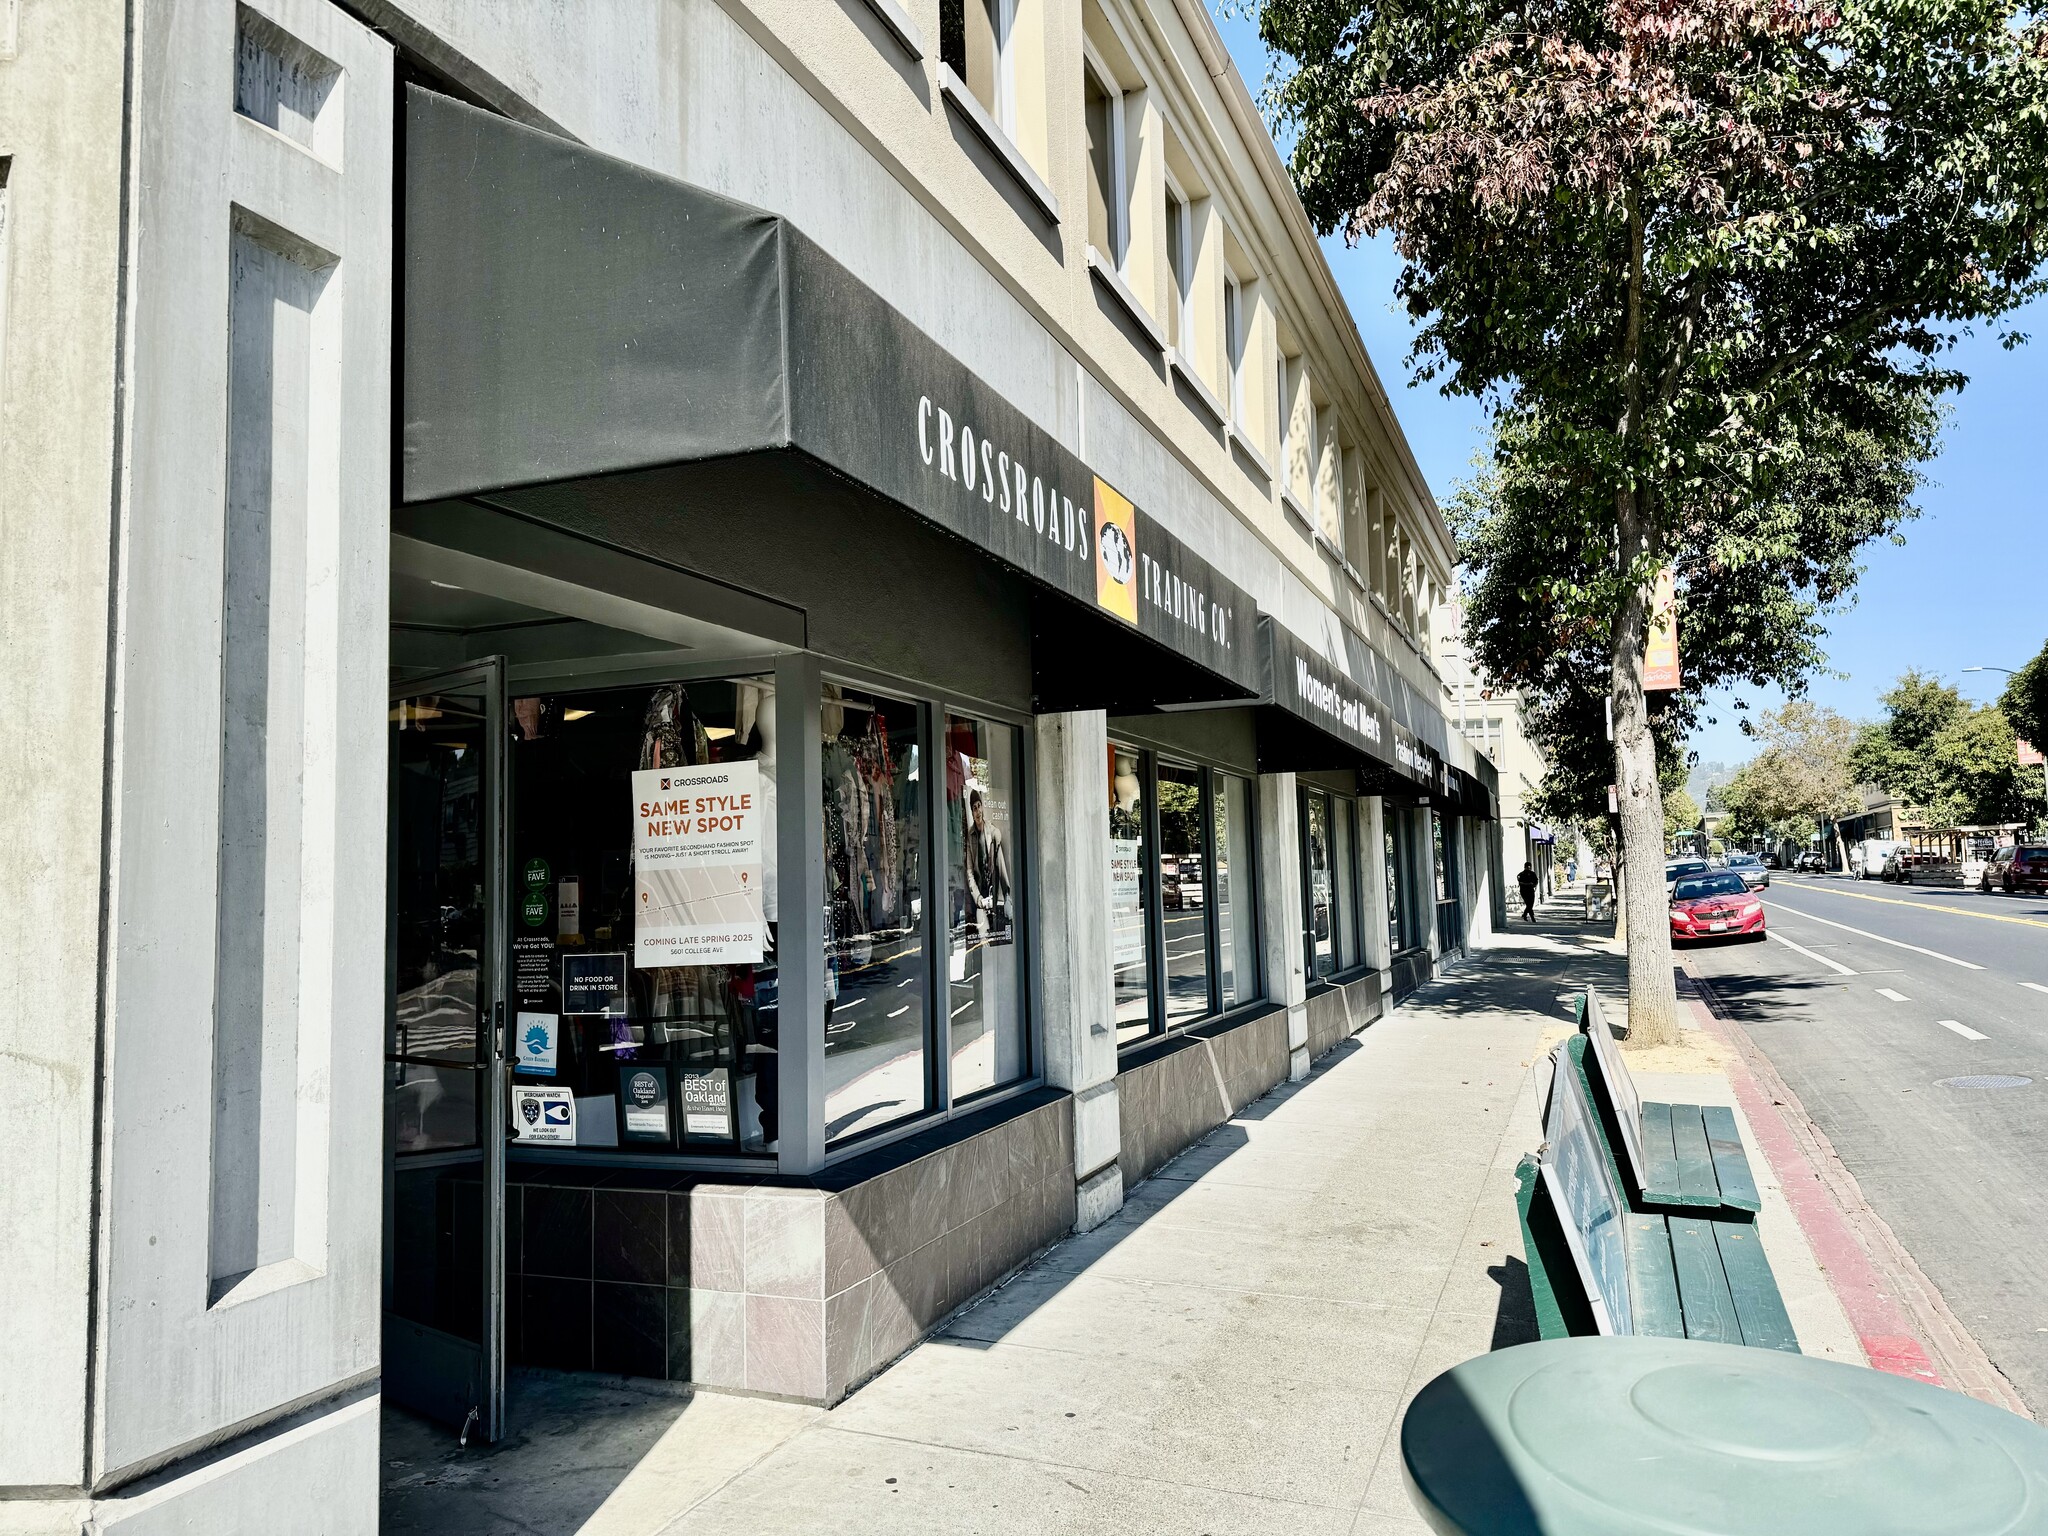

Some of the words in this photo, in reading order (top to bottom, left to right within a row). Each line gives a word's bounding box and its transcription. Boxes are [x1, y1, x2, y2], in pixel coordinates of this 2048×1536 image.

[918, 395, 1088, 561] CROSSROADS
[1142, 552, 1205, 635] TRADING
[1295, 655, 1341, 721] Women's
[1342, 698, 1358, 731] and
[1359, 702, 1381, 744] Men's
[673, 774, 729, 788] CROSSROADS
[640, 799, 690, 818] SAME
[695, 794, 752, 814] STYLE
[648, 819, 691, 837] NEW
[697, 815, 744, 834] SPOT
[654, 845, 679, 853] FAVORITE
[679, 843, 716, 851] SECONDHAND
[1123, 859, 1137, 869] STYLE
[527, 871, 546, 882] FAVE
[525, 906, 544, 916] FAVE
[643, 937, 677, 946] COMING
[679, 936, 699, 945] LATE
[701, 934, 730, 944] SPRING
[732, 933, 753, 942] 2025
[684, 947, 711, 955] COLLEGE
[569, 984, 589, 992] DRINK
[634, 1080, 648, 1088] BEST
[647, 1080, 654, 1088] of
[684, 1079, 714, 1091] BEST
[714, 1079, 726, 1092] of
[685, 1091, 726, 1103] Oakland
